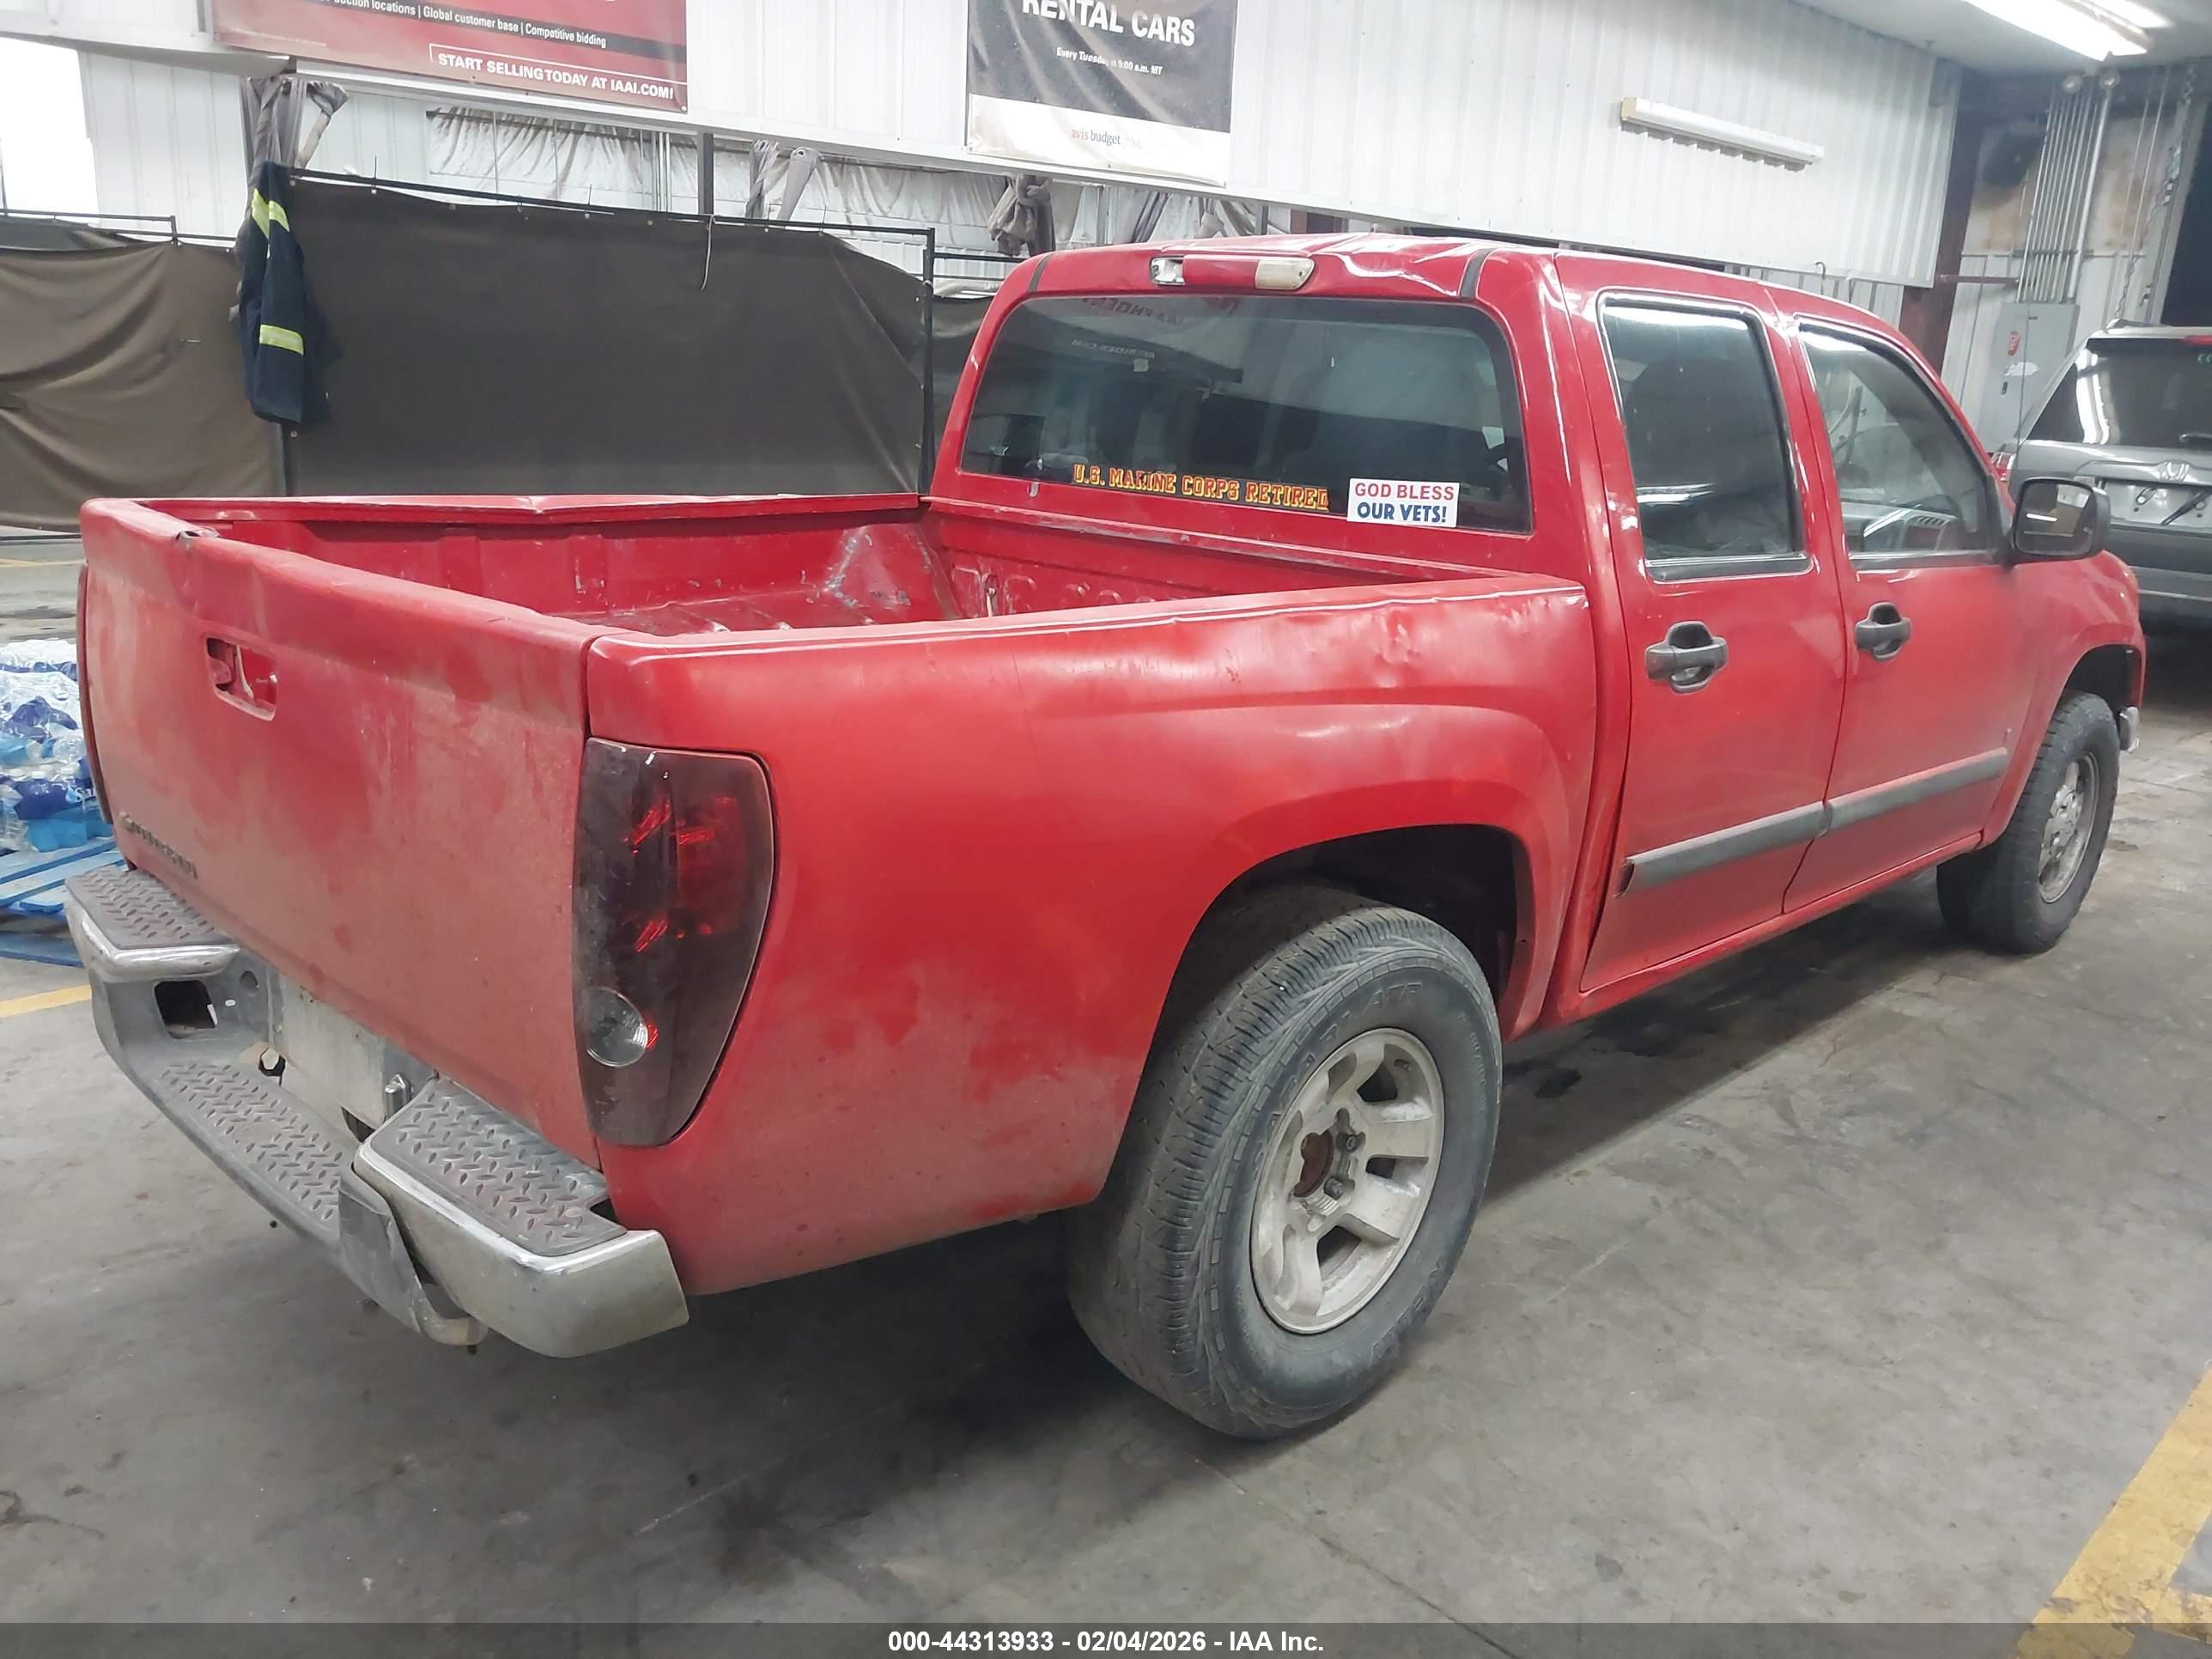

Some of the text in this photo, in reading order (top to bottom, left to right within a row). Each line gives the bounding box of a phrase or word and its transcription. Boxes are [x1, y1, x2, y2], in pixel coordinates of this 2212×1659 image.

[371, 0, 416, 15] locations
[423, 6, 453, 21] Global
[454, 13, 495, 28] customer
[497, 18, 519, 33] base
[526, 23, 575, 42] Competitive
[576, 32, 606, 49] bidding
[1132, 9, 1195, 47] CARS
[1056, 46, 1078, 61] Every
[438, 52, 674, 100] START SELLING TODAY AT IAAI.COM!
[1071, 128, 1089, 141] avis
[1091, 129, 1121, 147] budget
[1073, 464, 1329, 512] U.S. MARINE CORPS RETIRED
[1354, 483, 1455, 501] GOD BLESS
[1357, 501, 1448, 523] OUR VETS!
